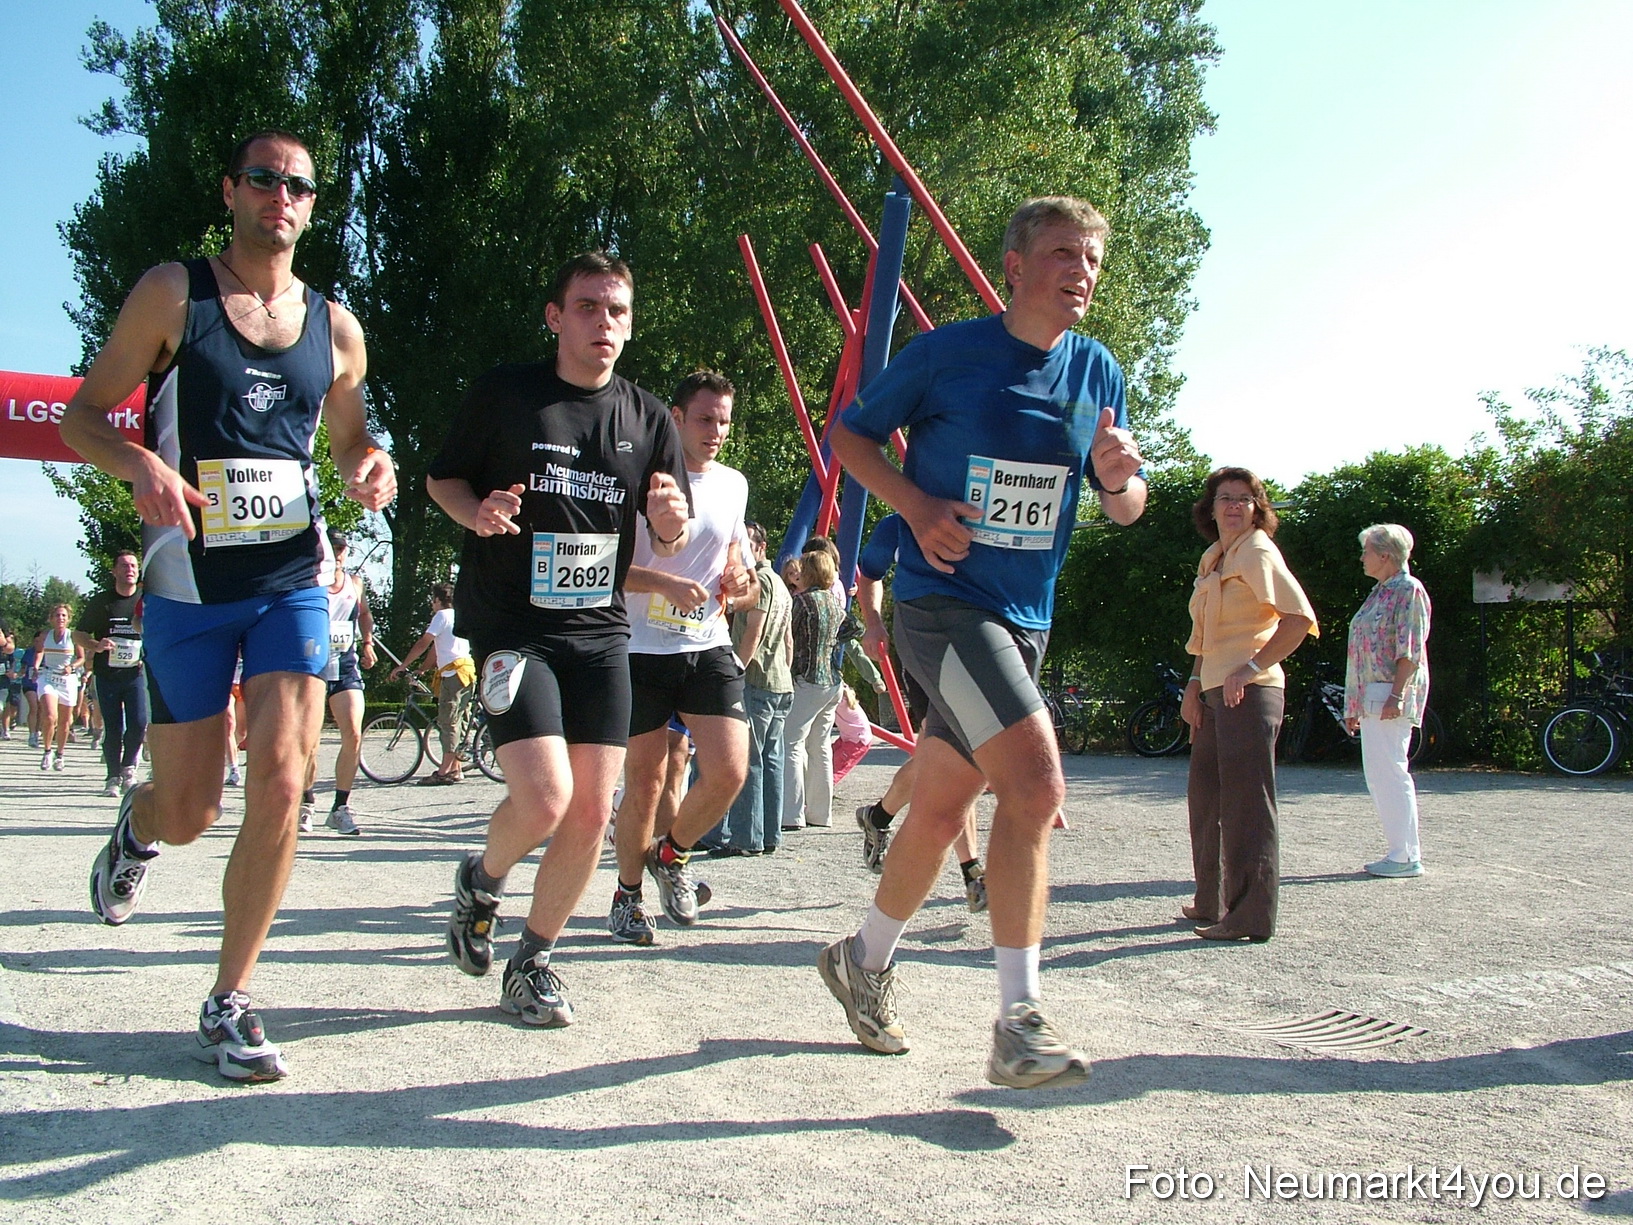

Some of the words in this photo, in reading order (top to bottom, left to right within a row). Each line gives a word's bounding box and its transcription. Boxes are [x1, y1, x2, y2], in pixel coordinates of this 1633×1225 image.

[531, 442, 570, 455] powered
[571, 446, 581, 458] by
[226, 468, 273, 483] Volker
[545, 462, 617, 487] Neumarkter
[994, 469, 1057, 490] Bernhard
[529, 473, 626, 504] Lammsbräu
[971, 488, 982, 502] B
[231, 495, 284, 520] 300
[989, 498, 1052, 526] 2161
[556, 542, 597, 556] Florian
[537, 561, 547, 573] B
[556, 566, 610, 588] 2692
[117, 652, 133, 660] 529
